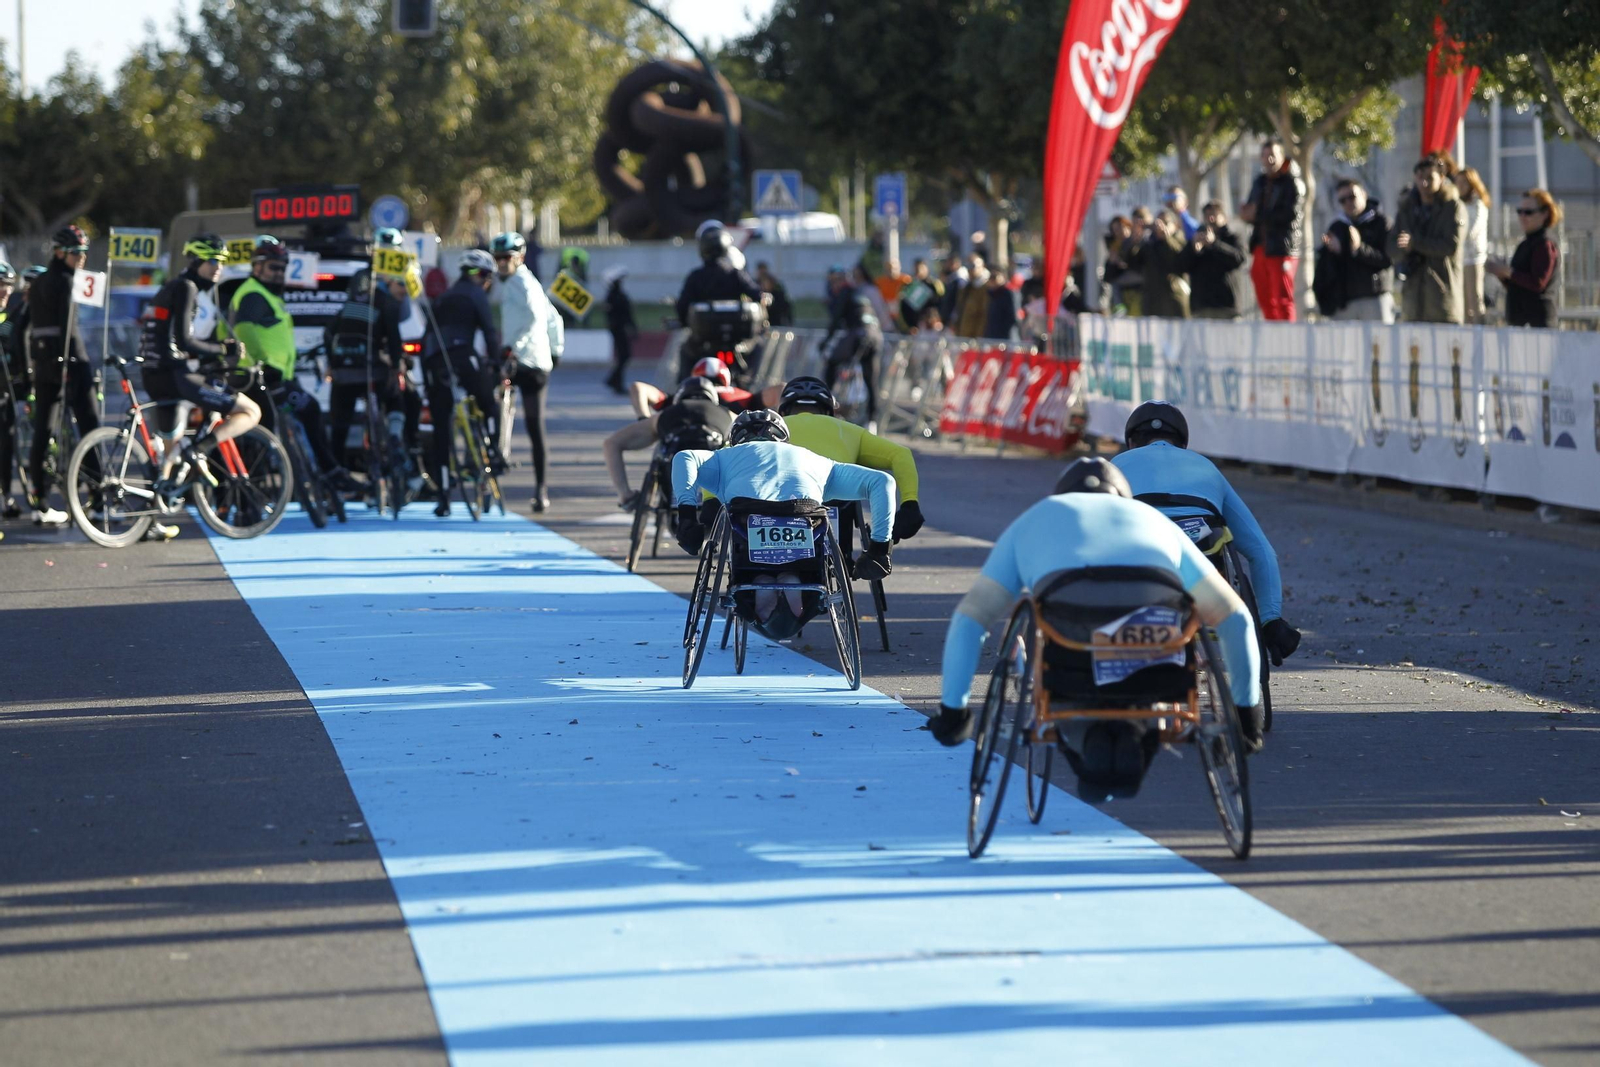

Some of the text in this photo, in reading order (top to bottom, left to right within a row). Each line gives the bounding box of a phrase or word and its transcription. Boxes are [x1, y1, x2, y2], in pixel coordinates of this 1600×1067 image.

[113, 237, 155, 258] 1:40
[290, 258, 303, 280] 2
[83, 276, 96, 298] 3
[554, 276, 591, 312] 1:30
[756, 527, 807, 543] 1684
